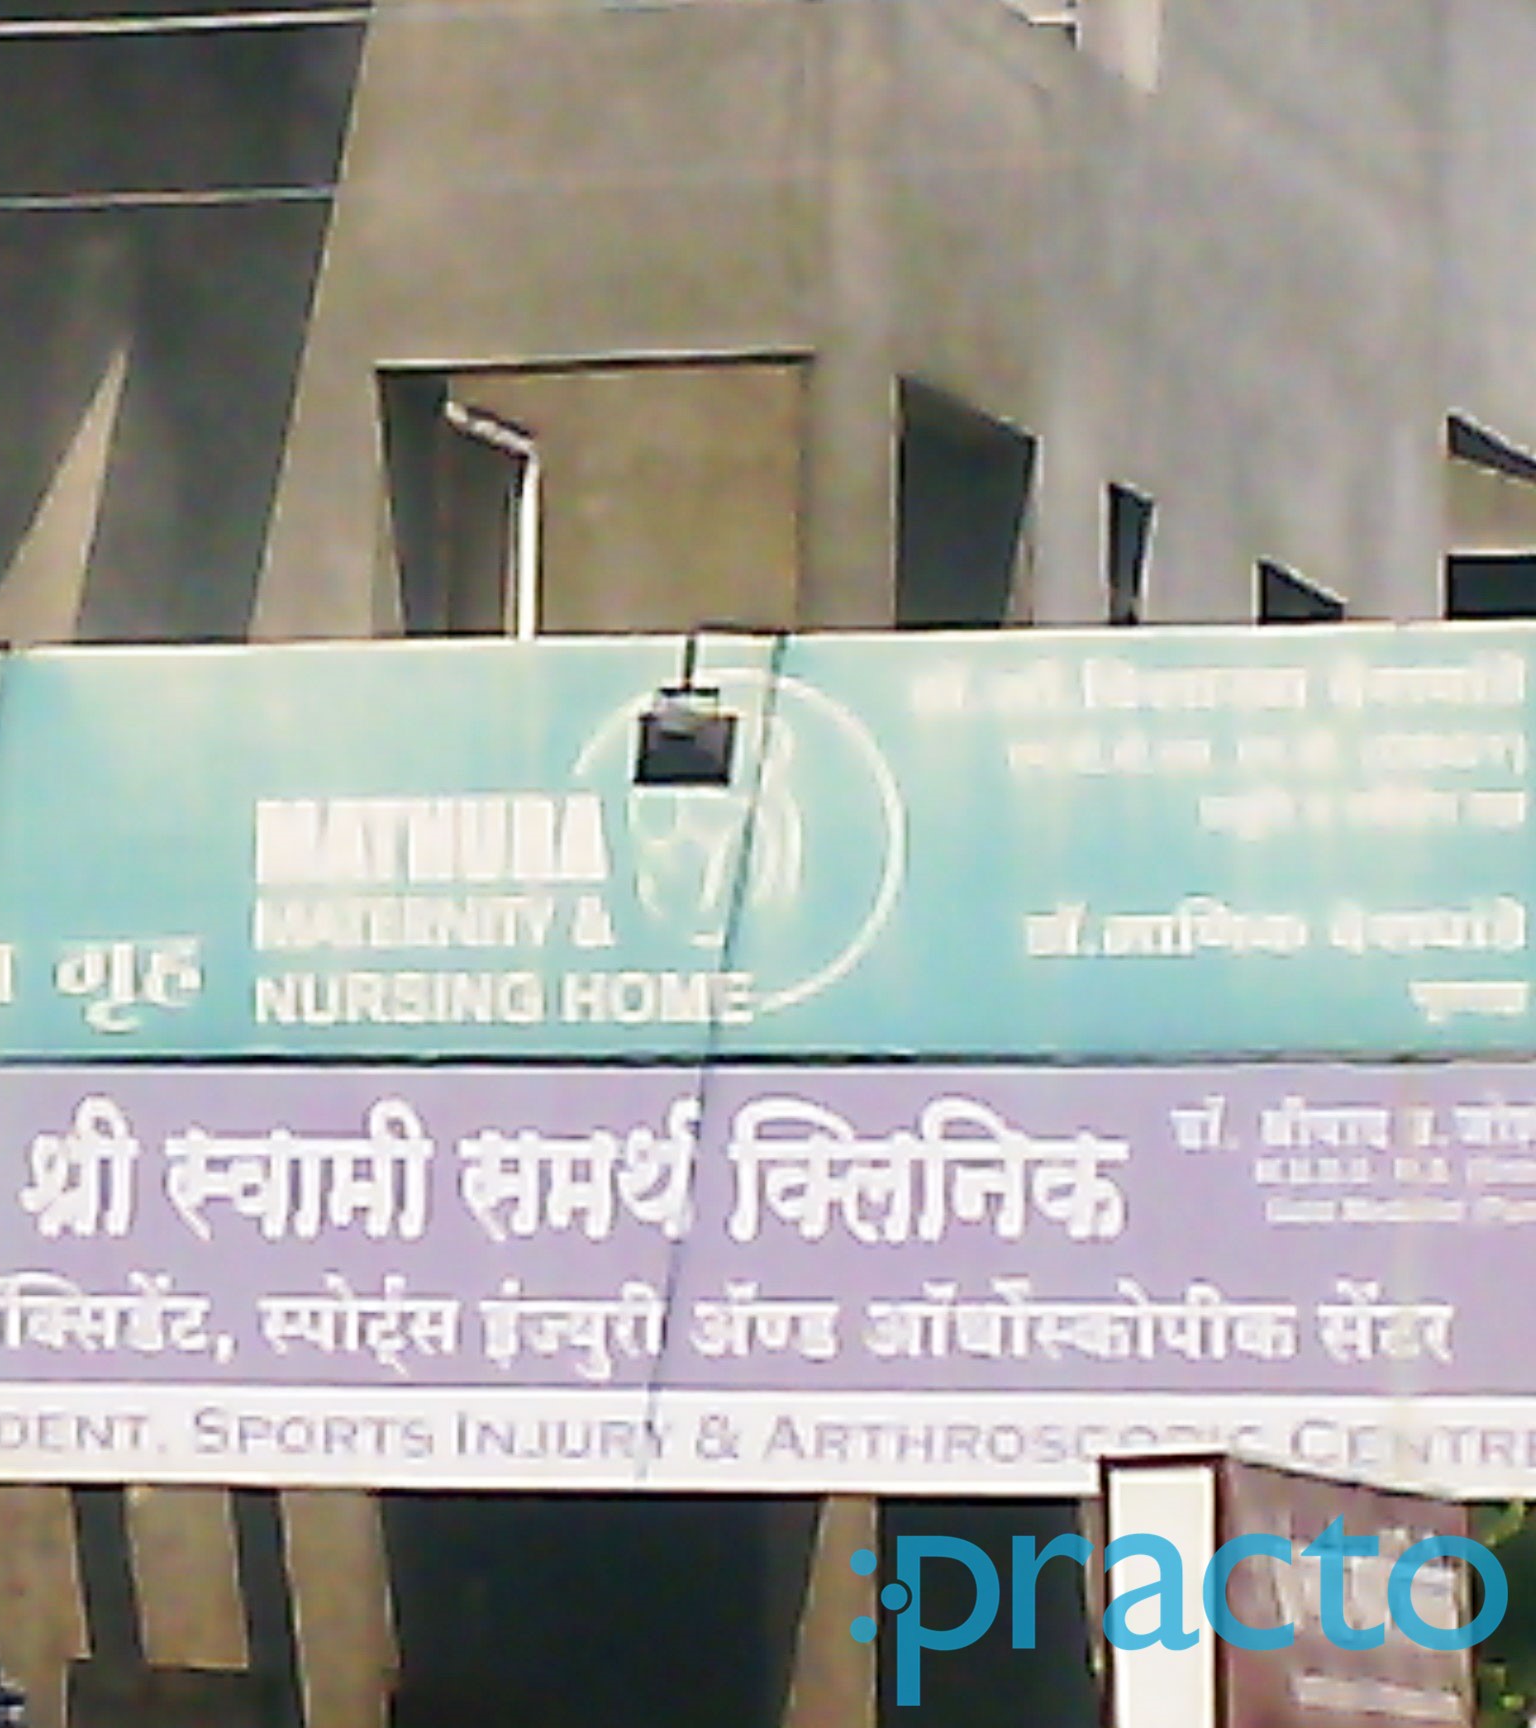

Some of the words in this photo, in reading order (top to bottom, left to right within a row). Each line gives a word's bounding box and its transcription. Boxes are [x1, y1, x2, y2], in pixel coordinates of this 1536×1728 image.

[254, 797, 610, 884] MATHURA
[254, 896, 554, 950] MATERNITY
[572, 896, 616, 948] &
[254, 972, 546, 1024] NURSING
[562, 970, 756, 1024] HOME
[19, 1095, 140, 1238] श्री
[164, 1098, 434, 1242] स्वामी
[456, 1098, 702, 1244] समर्थ
[726, 1096, 1132, 1244] क्लिनिक
[192, 1404, 434, 1458] SPORTS
[454, 1406, 666, 1462] INJURY
[694, 1412, 742, 1464] &
